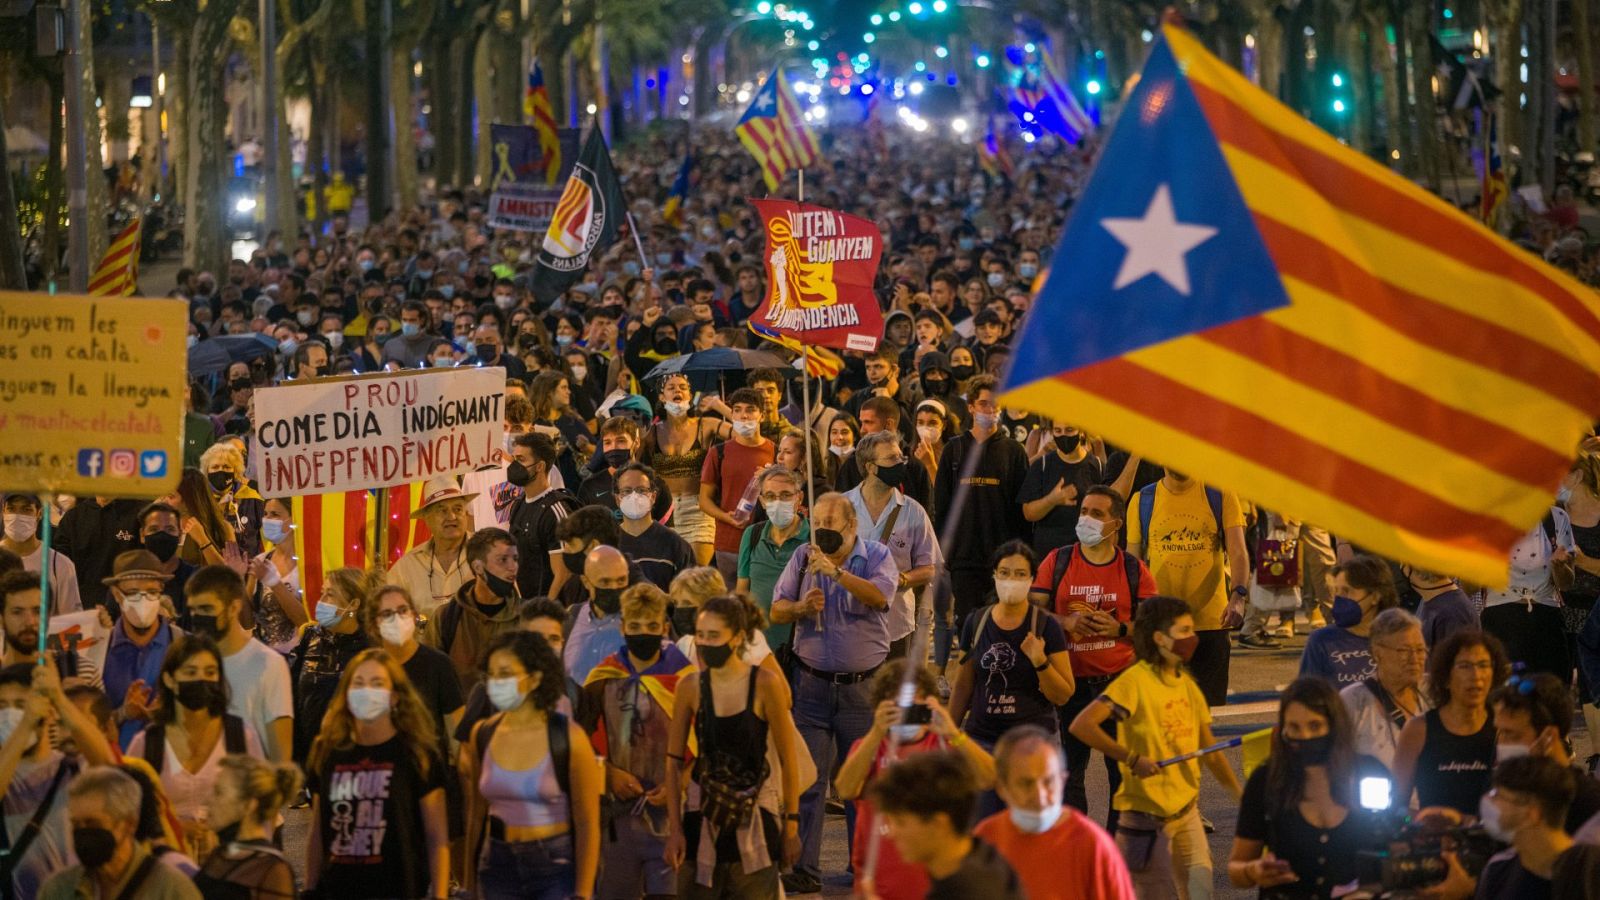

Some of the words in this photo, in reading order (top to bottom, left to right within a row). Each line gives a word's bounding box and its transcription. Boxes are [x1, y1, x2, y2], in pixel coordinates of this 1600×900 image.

[807, 236, 873, 264] GUANYEM
[90, 303, 118, 333] les
[30, 344, 52, 360] en
[68, 373, 87, 396] la
[104, 372, 171, 408] llengua
[345, 379, 419, 410] PROU
[1070, 585, 1100, 595] LLUITEM
[1330, 650, 1371, 665] Sprea
